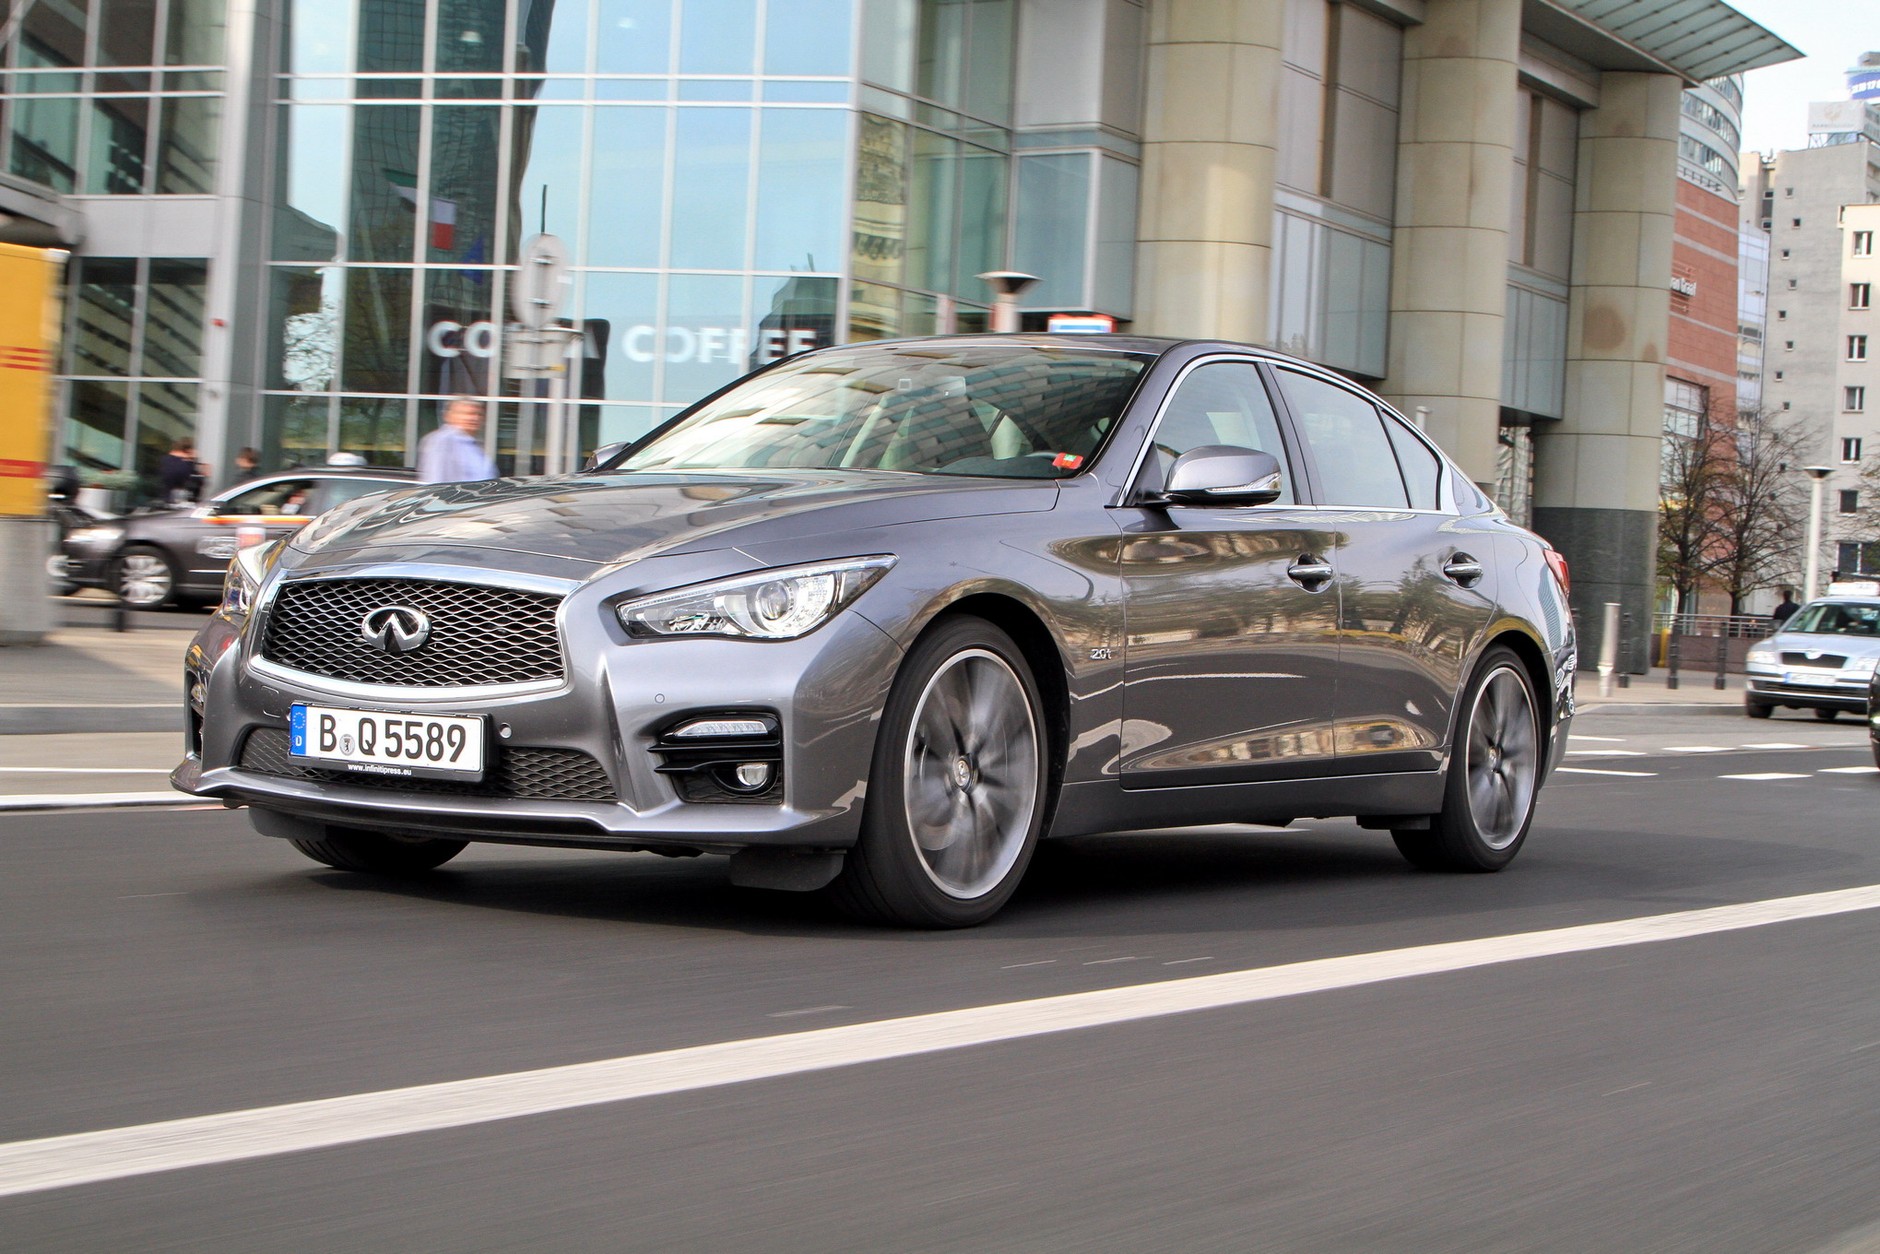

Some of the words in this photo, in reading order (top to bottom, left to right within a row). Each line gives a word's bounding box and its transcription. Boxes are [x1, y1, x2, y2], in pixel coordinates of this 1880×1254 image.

[295, 735, 303, 747] D
[319, 713, 337, 752] B
[358, 717, 376, 756] Q
[384, 719, 467, 763] 5589
[347, 763, 412, 776] www.infinitipress.eu
